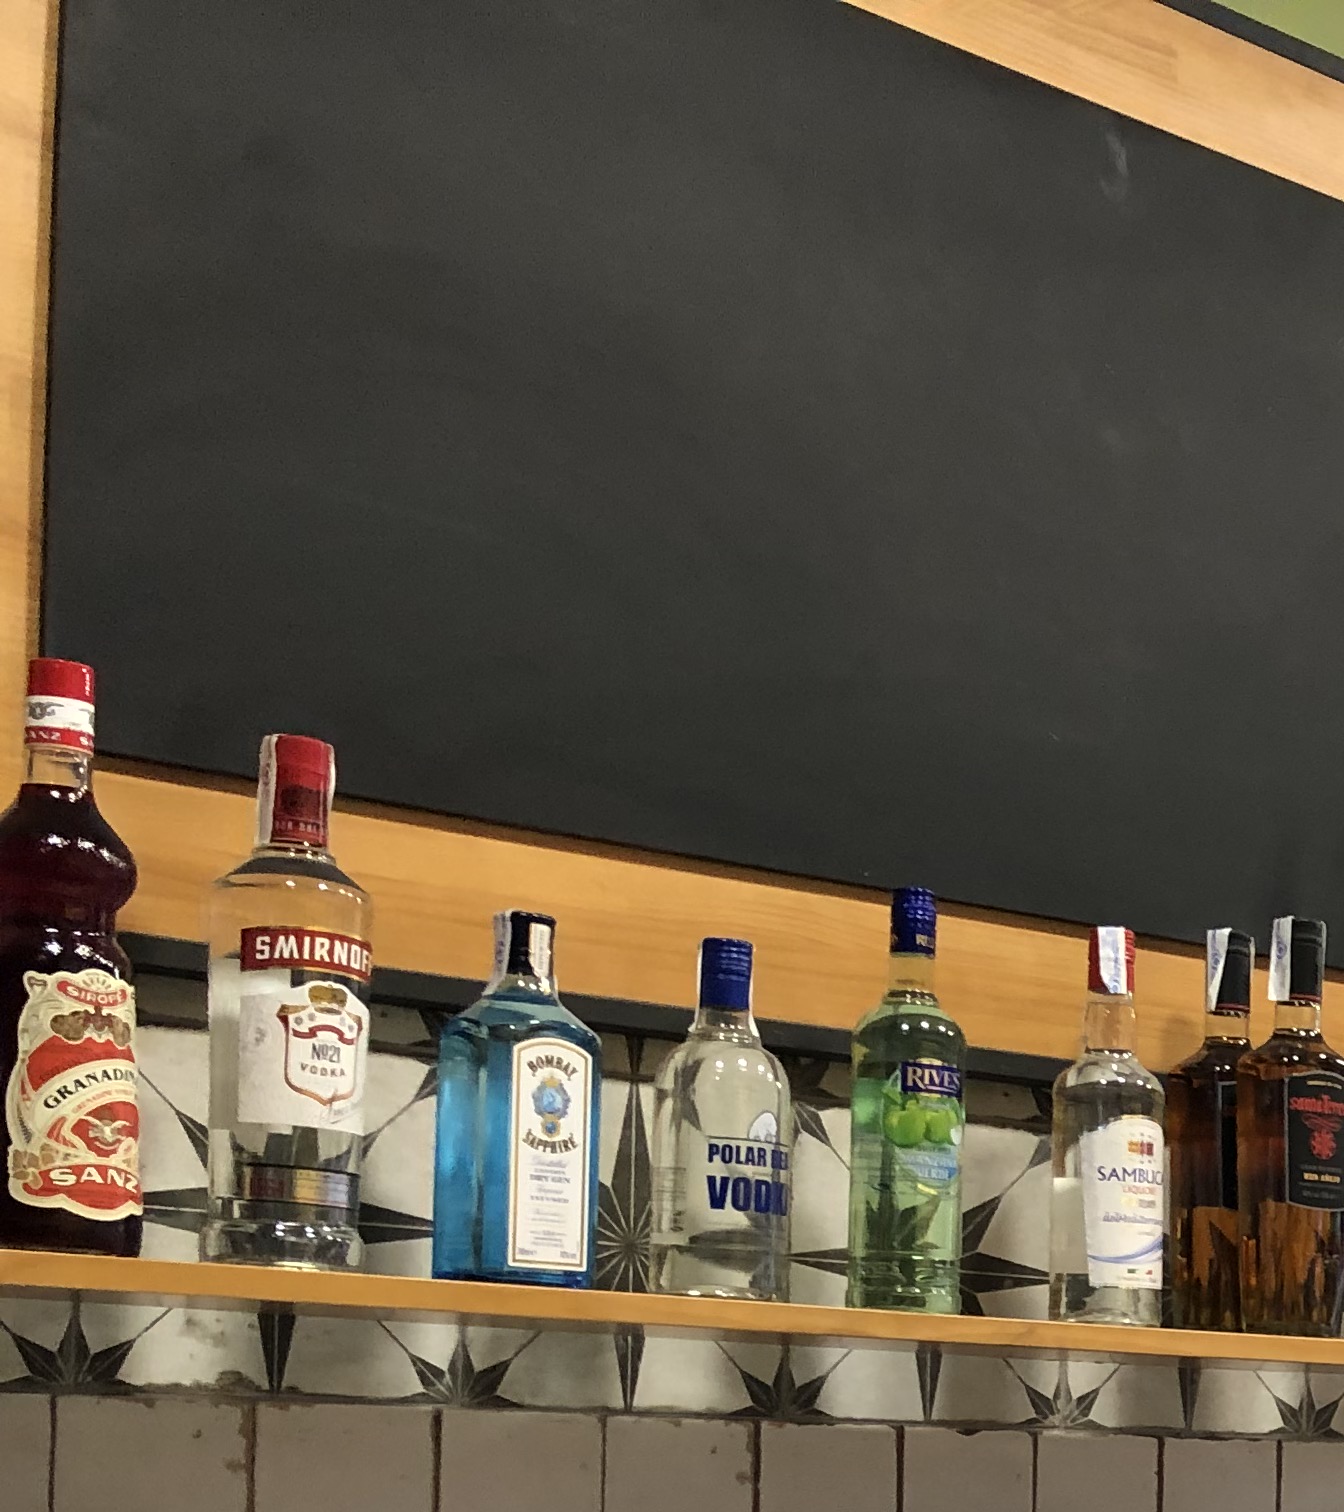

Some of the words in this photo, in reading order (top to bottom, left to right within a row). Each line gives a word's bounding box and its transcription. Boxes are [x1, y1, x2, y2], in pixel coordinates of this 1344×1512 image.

[300, 1061, 347, 1078] VODKA
[526, 1054, 579, 1081] BOMBAY
[905, 1065, 961, 1093] RIVES
[521, 1128, 579, 1154] SAPPHIRE
[707, 1144, 768, 1169] POLAR
[49, 1164, 139, 1194] SANZ
